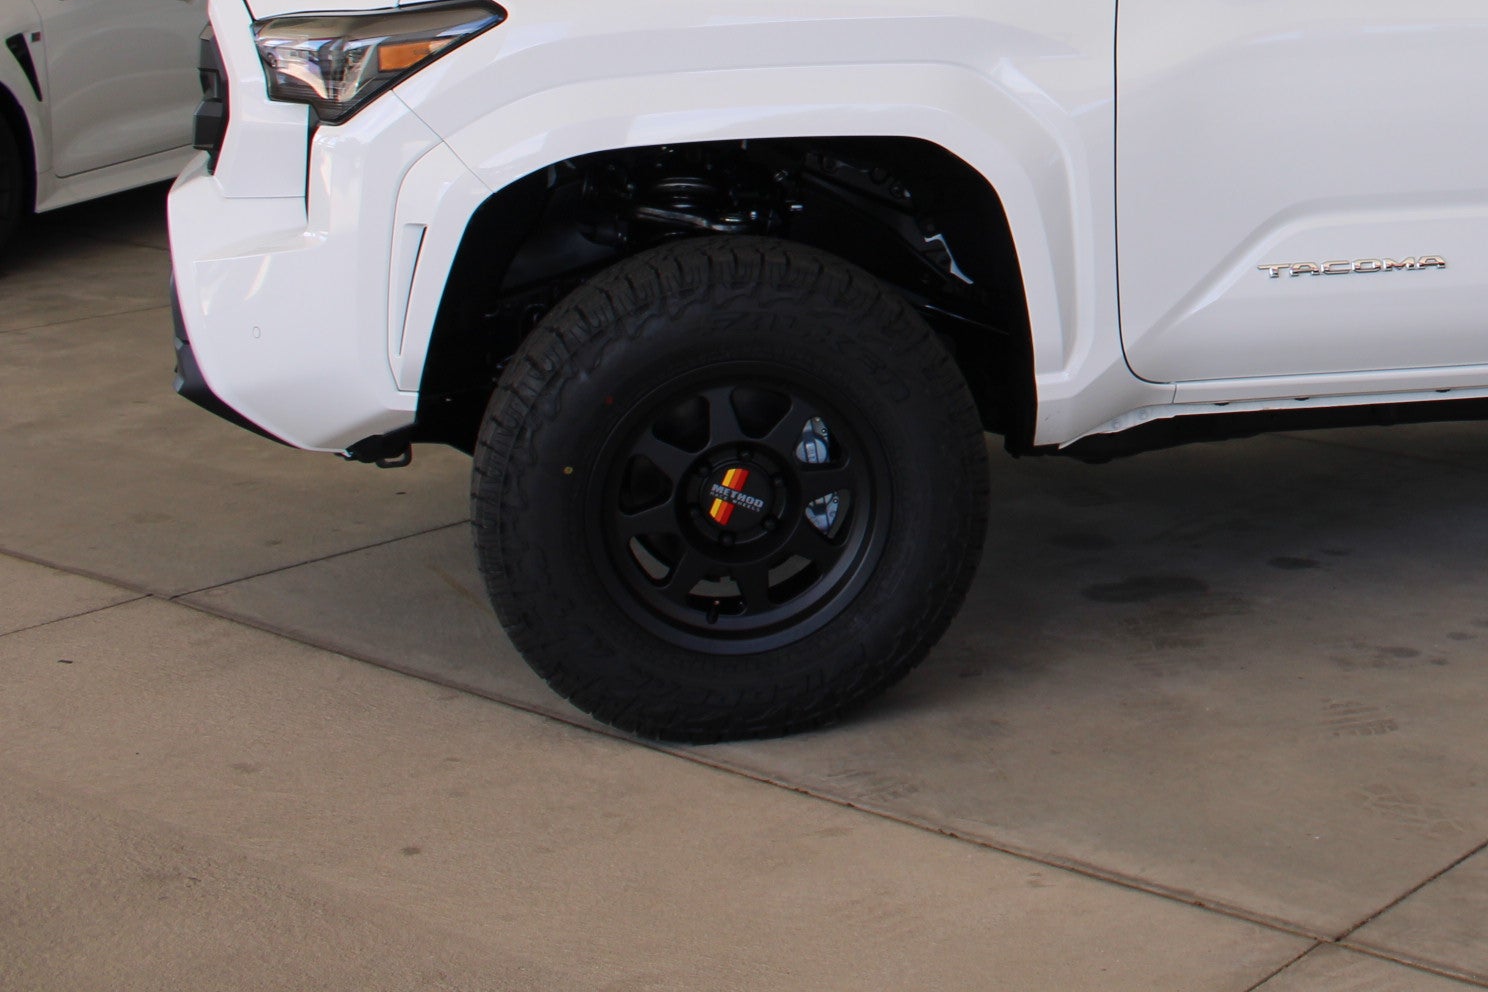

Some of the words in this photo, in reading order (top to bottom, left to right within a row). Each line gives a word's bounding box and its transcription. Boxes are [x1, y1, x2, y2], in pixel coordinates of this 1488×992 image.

[1257, 255, 1447, 278] TACOMA
[711, 483, 764, 508] METHOD
[732, 500, 761, 512] WHEELS
